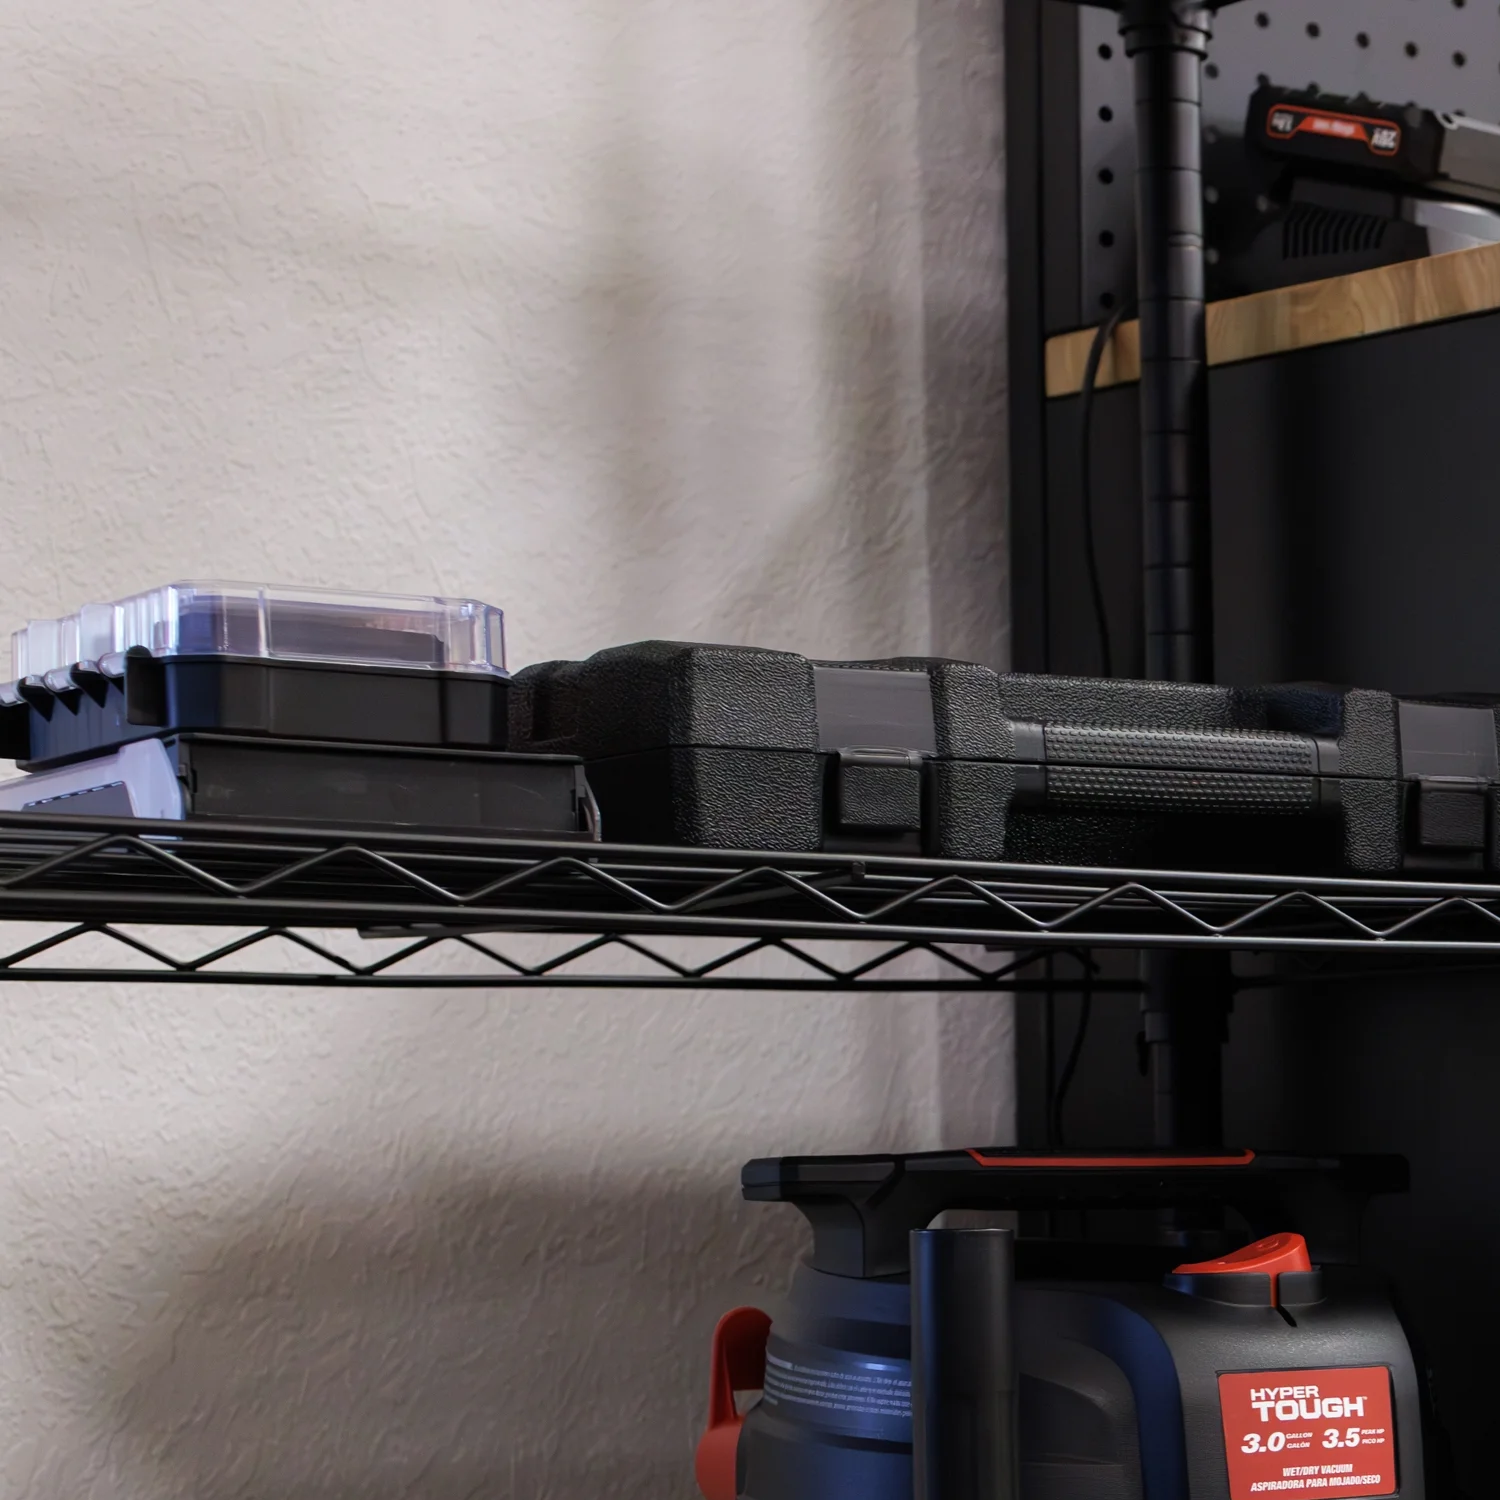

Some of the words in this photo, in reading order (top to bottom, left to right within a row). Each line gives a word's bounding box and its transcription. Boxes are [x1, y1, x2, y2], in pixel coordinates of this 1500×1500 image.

[1250, 1385, 1319, 1401] HYPER
[1252, 1396, 1364, 1422] TOUGH
[1241, 1431, 1286, 1454] 3.0
[1286, 1441, 1311, 1449] GALÓN
[1322, 1427, 1361, 1449] 3.5
[1282, 1465, 1320, 1477] WET/DRY
[1321, 1463, 1353, 1475] VACUUM
[1250, 1479, 1304, 1492] ASPIRADORA
[1306, 1477, 1328, 1488] PARA
[1329, 1474, 1381, 1487] MOJADO/SECO
